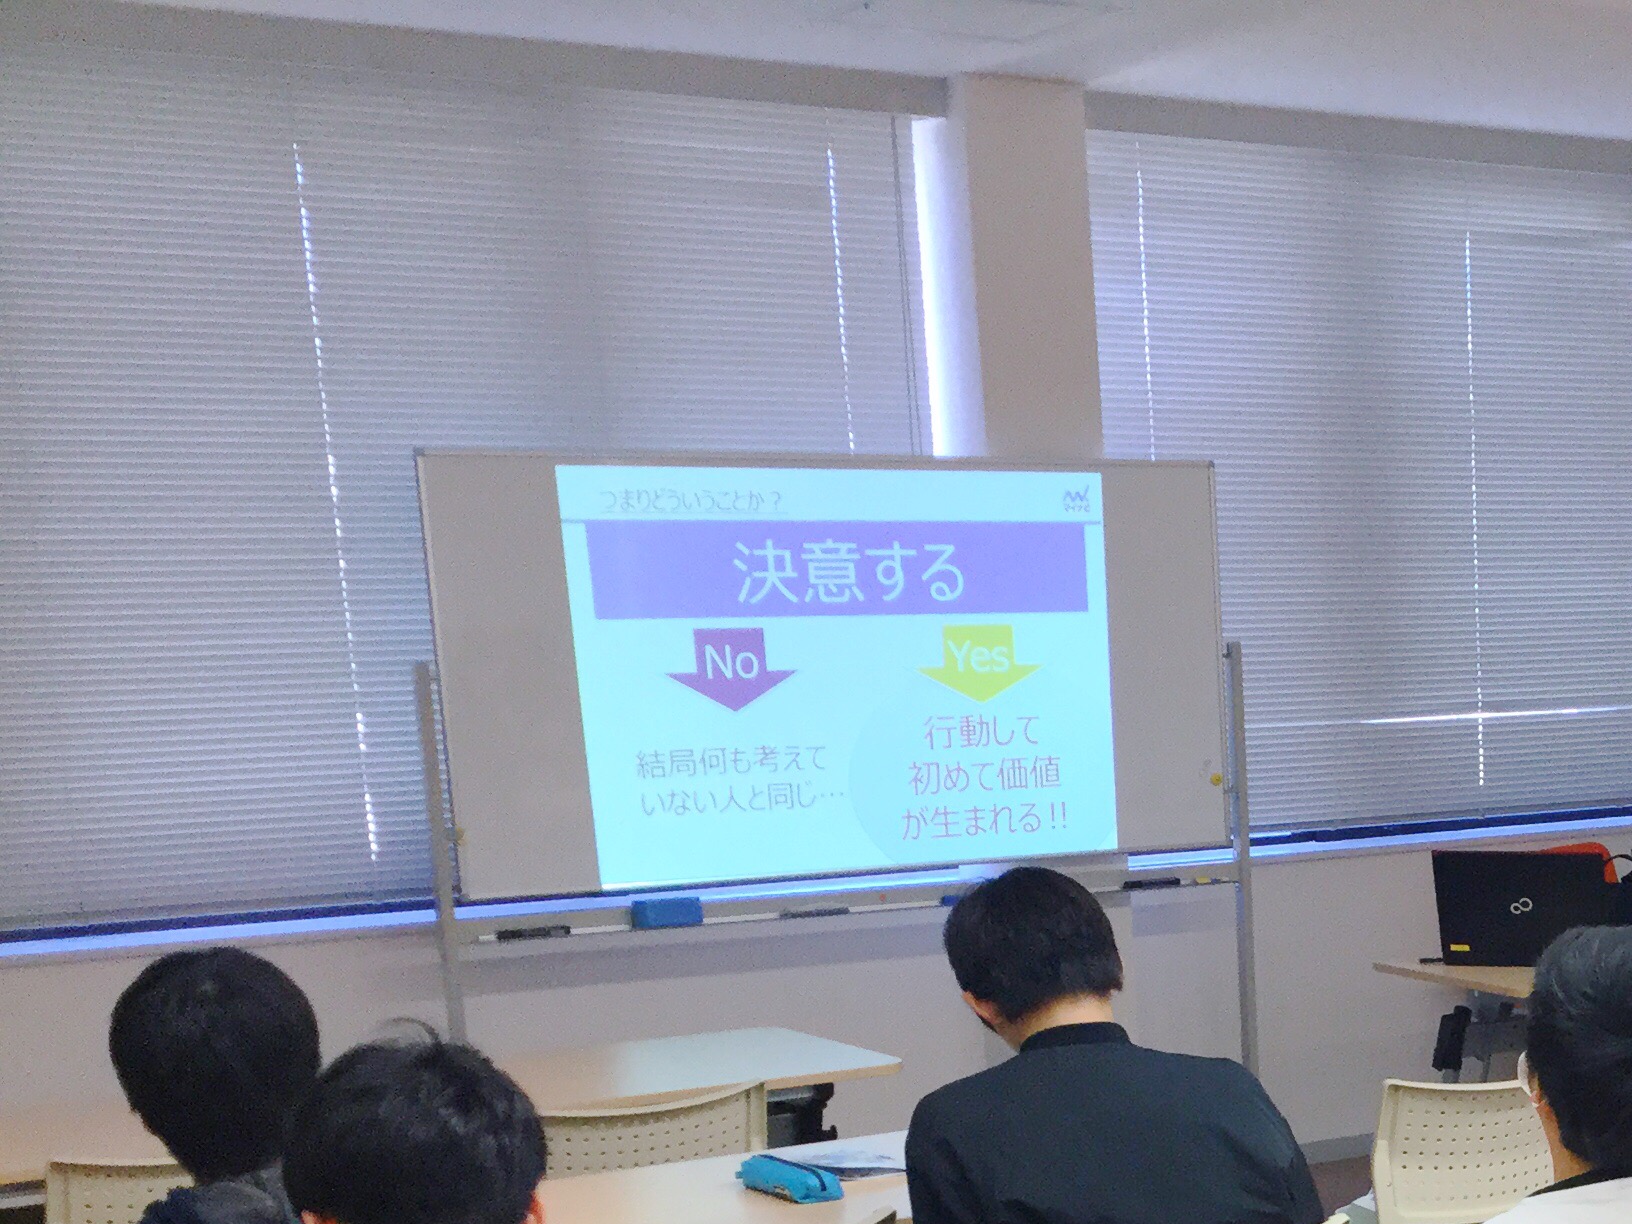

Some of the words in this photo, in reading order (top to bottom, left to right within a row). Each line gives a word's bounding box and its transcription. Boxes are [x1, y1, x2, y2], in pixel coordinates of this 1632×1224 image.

[733, 539, 965, 604] 決意する
[704, 645, 760, 681] No
[946, 640, 1010, 673] Yes
[924, 714, 1040, 750] 行動して
[636, 745, 827, 779] 結局何も考えて
[909, 756, 1062, 796] 初めて価値
